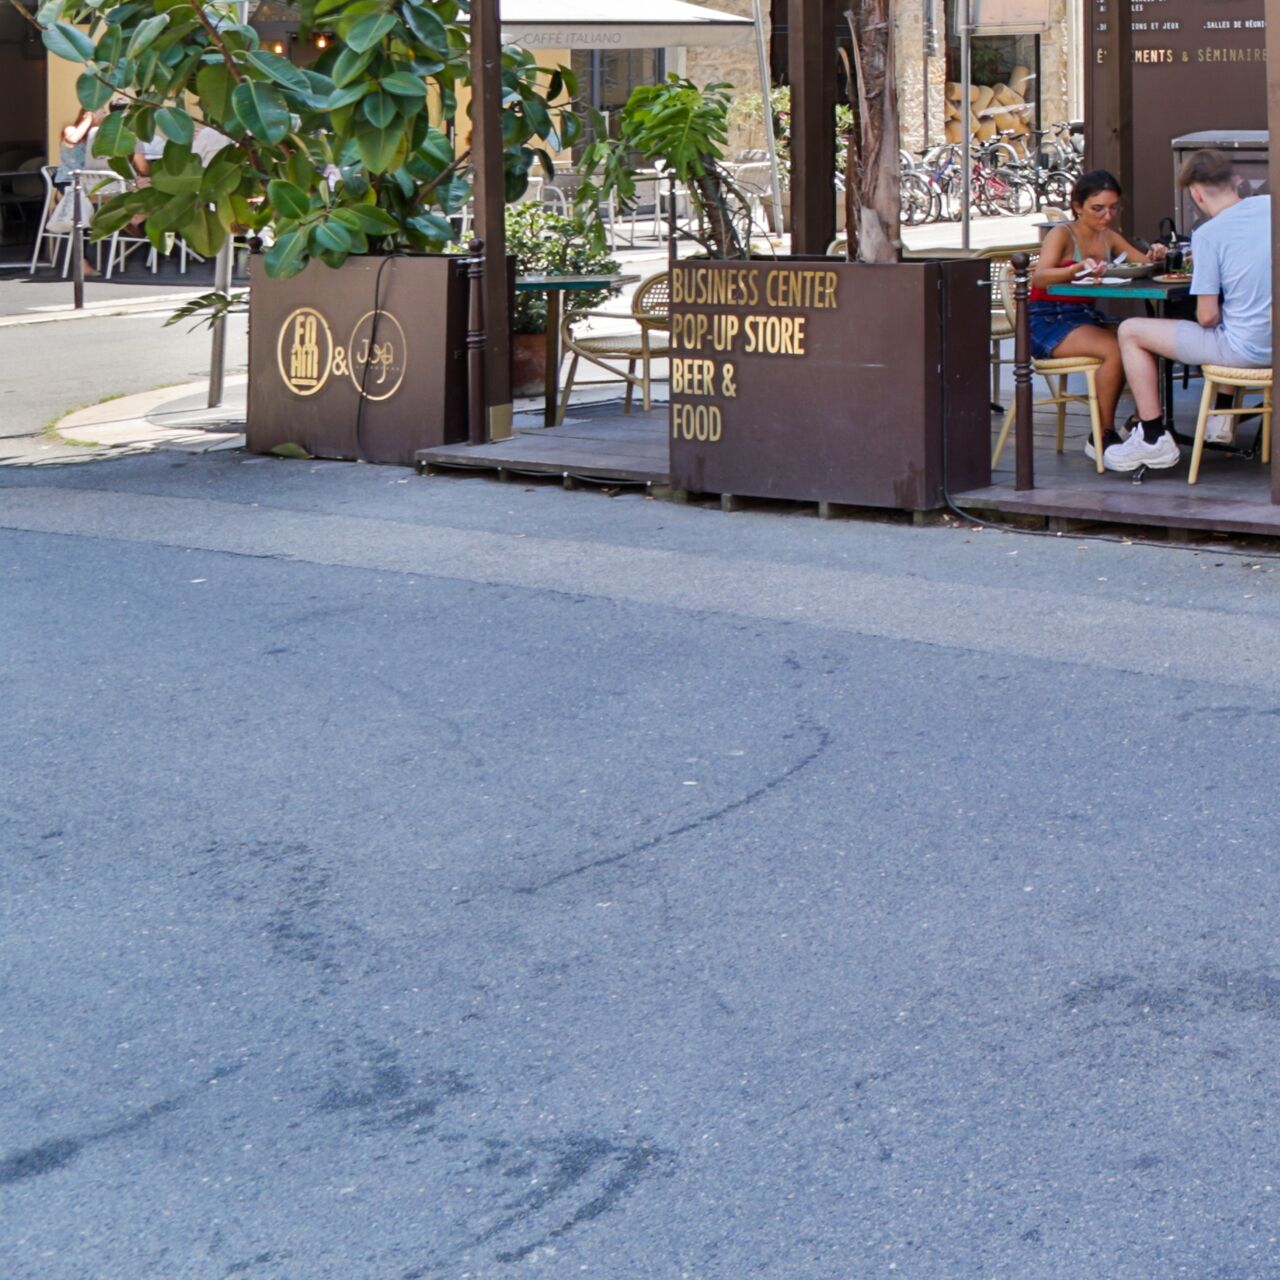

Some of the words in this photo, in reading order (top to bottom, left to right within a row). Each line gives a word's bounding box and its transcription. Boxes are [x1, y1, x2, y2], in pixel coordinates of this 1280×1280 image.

[566, 31, 622, 44] ITALIANO
[1162, 22, 1180, 30] JEUX
[1234, 20, 1242, 28] DE
[1245, 19, 1265, 29] RÉUNI
[1097, 48, 1173, 63] ÉMENTS
[1182, 51, 1189, 62] &
[1198, 47, 1267, 63] SÉMINAIRE
[672, 268, 759, 307] BUSINESS
[766, 270, 838, 309] CENTER
[672, 313, 739, 351] POP-UP
[744, 316, 806, 355] STORE
[332, 346, 349, 376] &
[672, 358, 715, 396] BEER
[722, 363, 737, 398] &
[672, 403, 722, 442] FOOD
